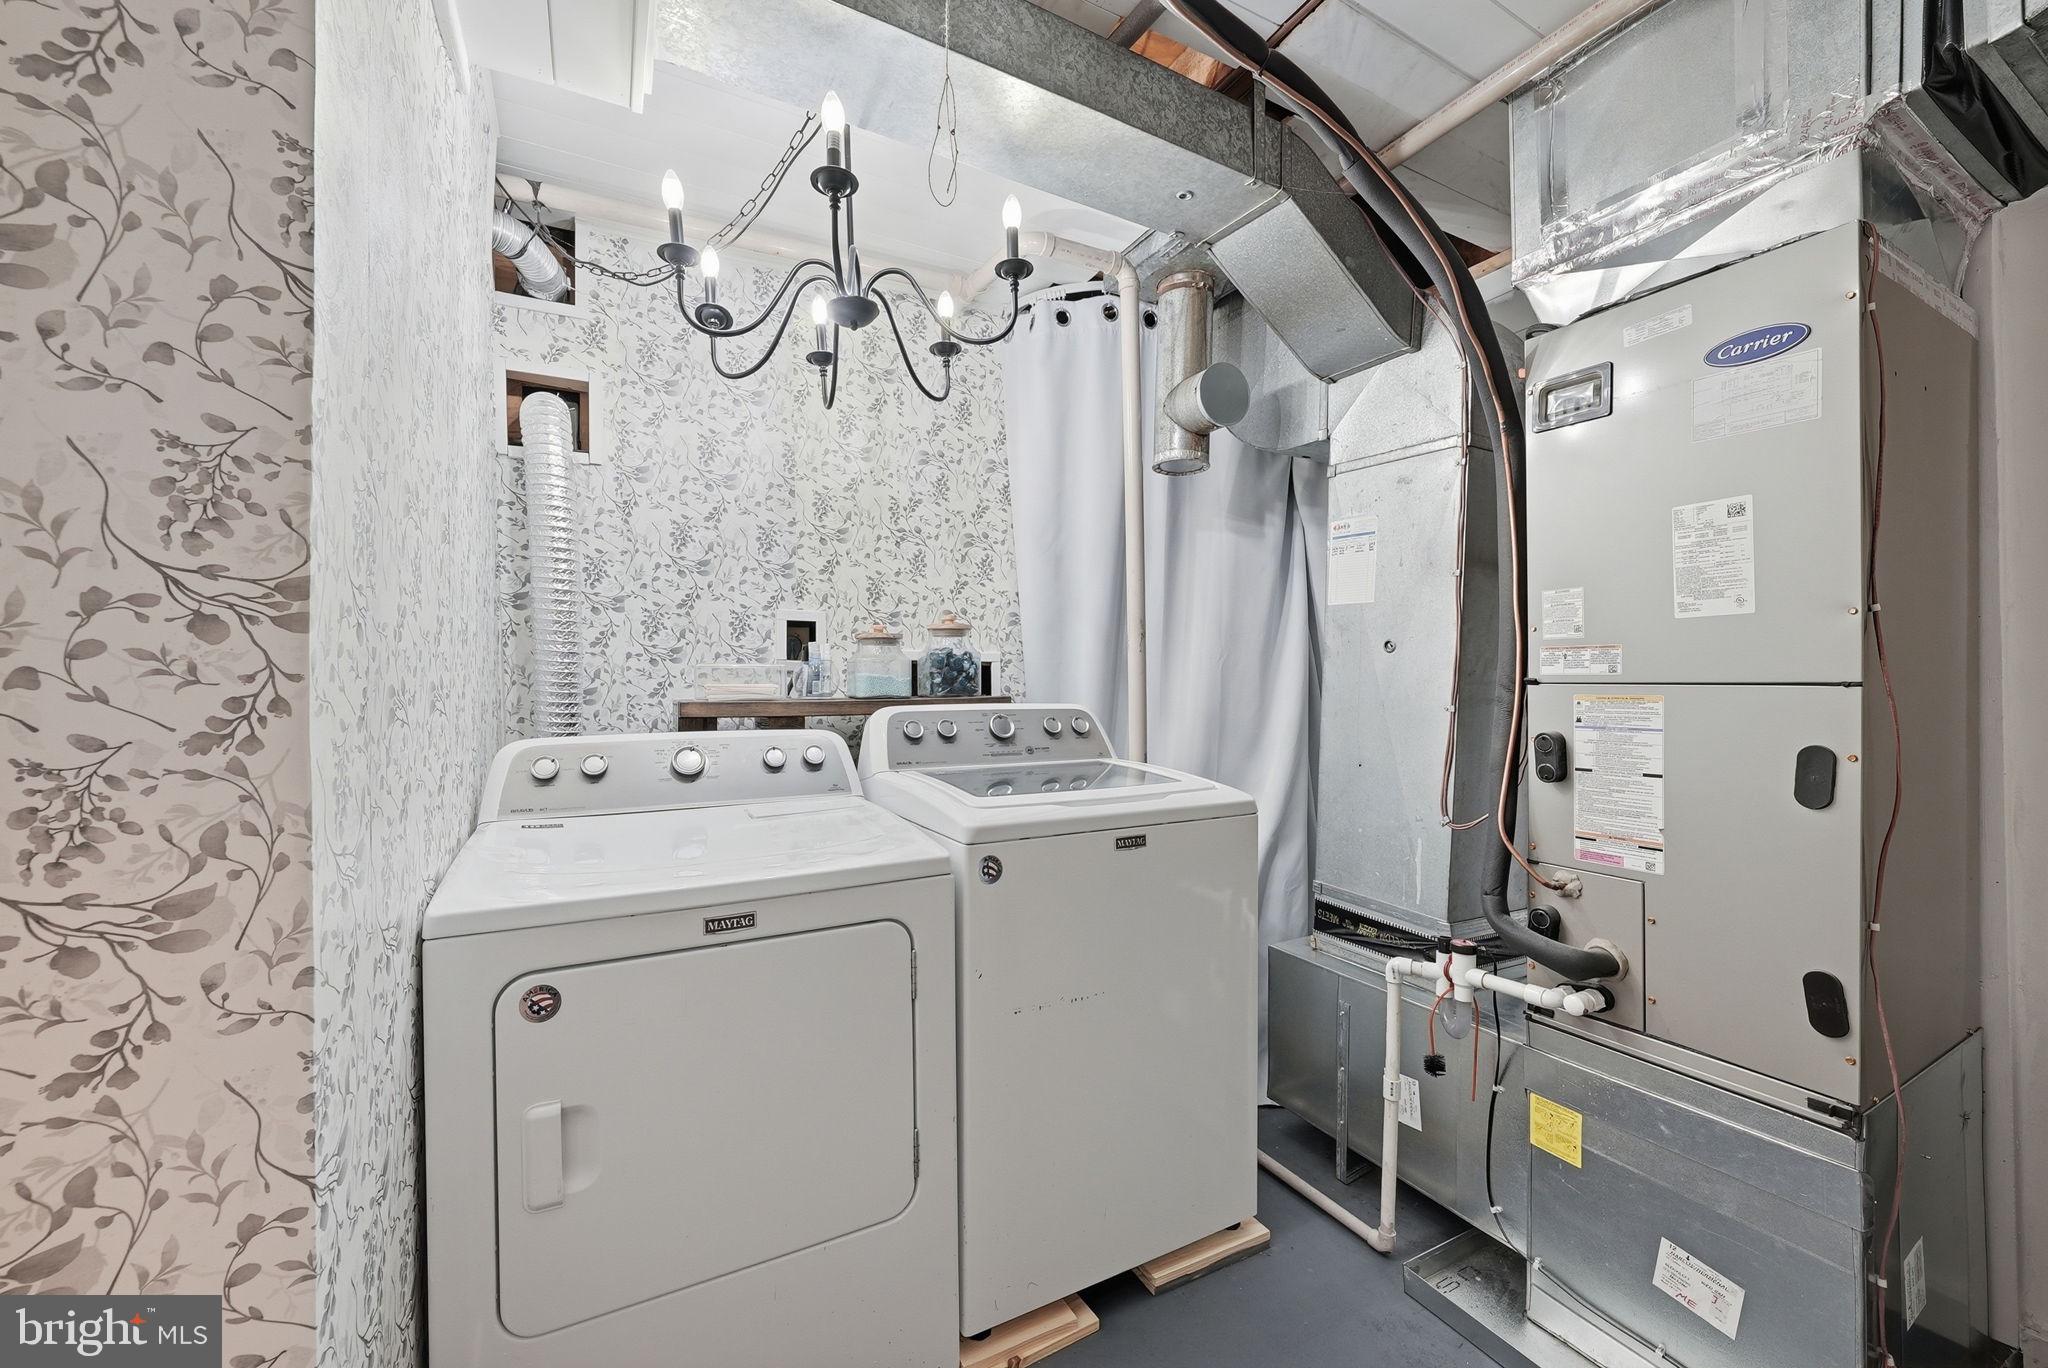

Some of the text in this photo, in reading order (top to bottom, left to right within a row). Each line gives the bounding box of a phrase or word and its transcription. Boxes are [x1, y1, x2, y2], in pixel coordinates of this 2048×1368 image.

[1717, 330, 1794, 359] Carrier
[1117, 837, 1145, 848] MAYTAG
[707, 916, 753, 931] MAYTAG
